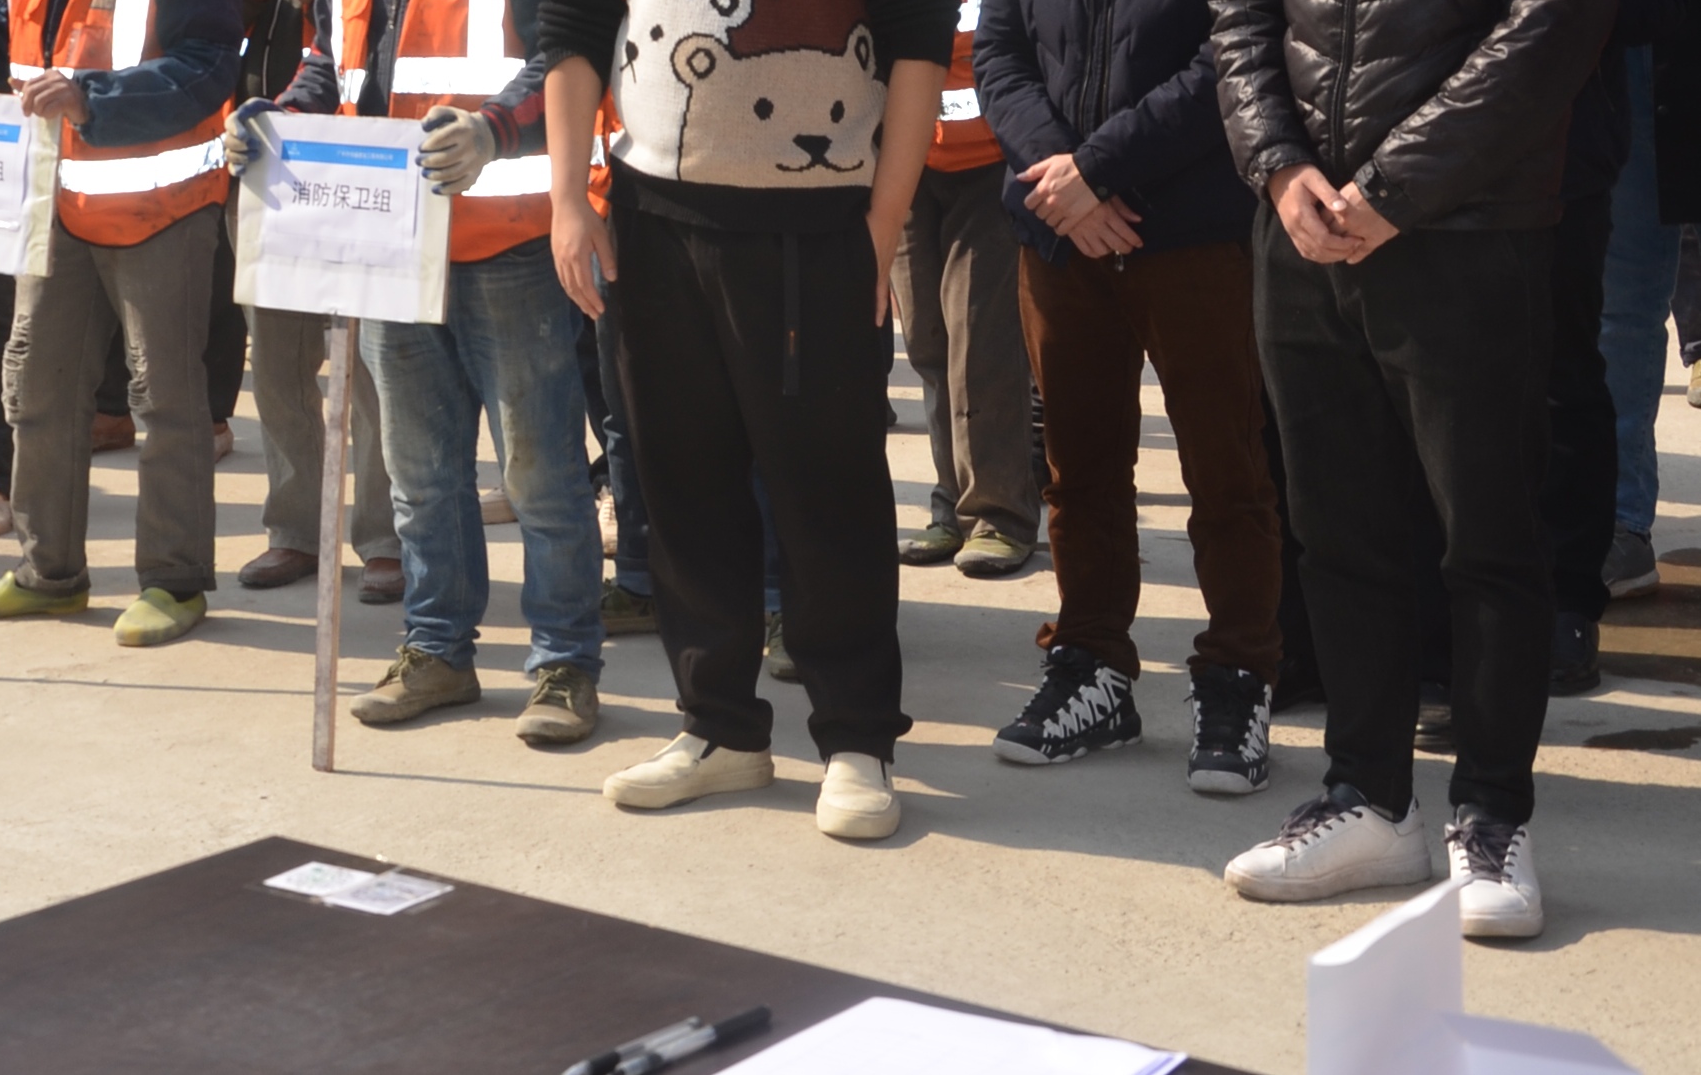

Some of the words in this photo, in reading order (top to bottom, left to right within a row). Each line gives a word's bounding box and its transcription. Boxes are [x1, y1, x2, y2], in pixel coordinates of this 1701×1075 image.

[292, 180, 391, 212] 消防保卫组
